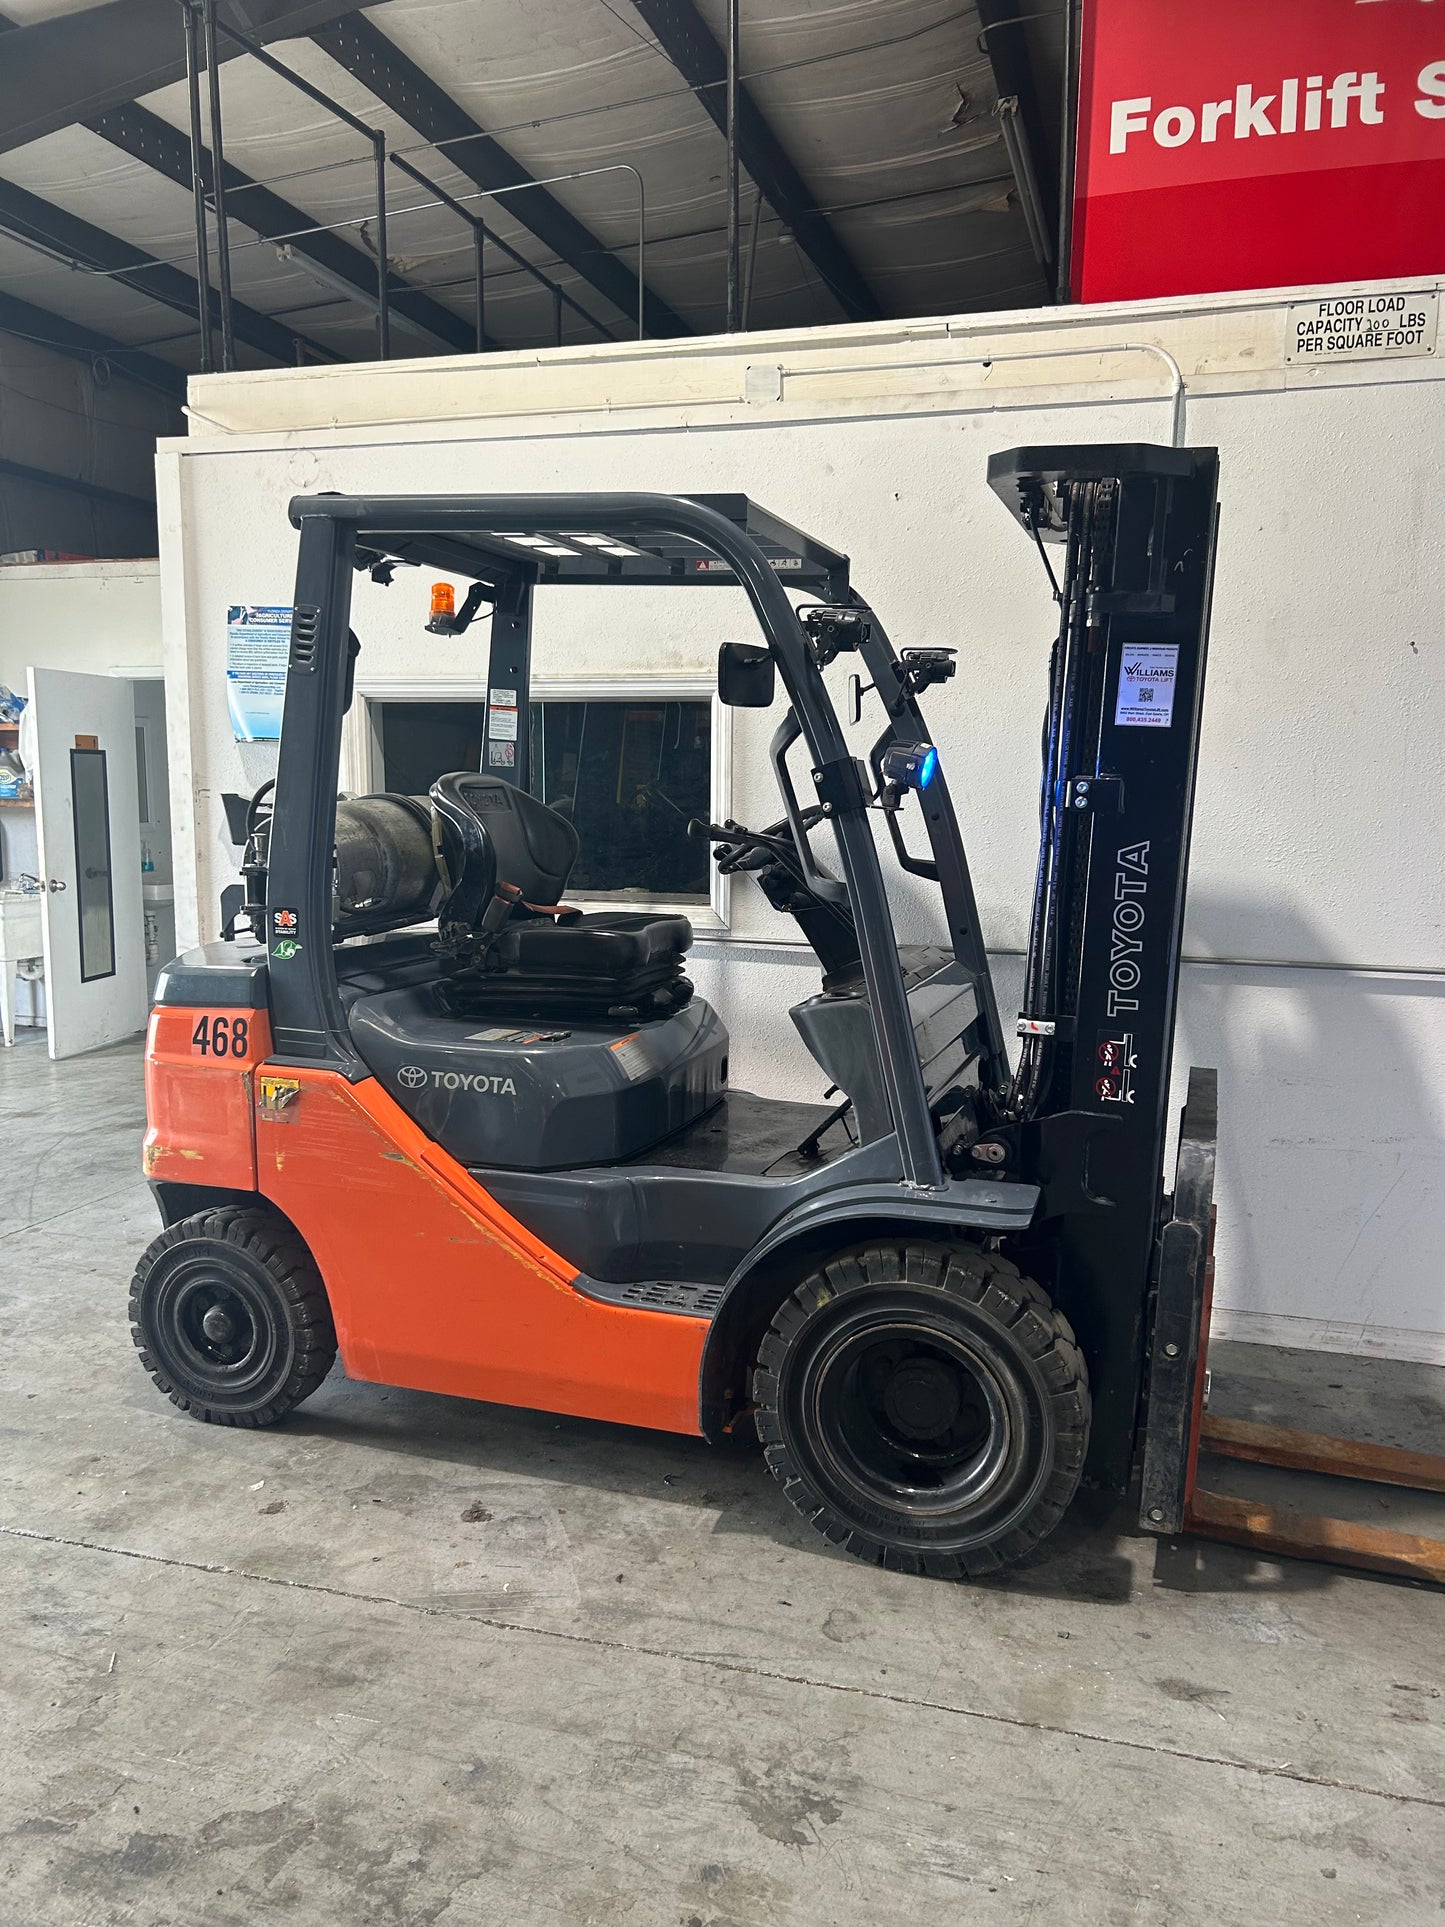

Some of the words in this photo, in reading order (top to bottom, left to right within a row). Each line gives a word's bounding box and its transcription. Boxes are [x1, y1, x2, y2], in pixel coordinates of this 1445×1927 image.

[1109, 71, 1385, 155] Forklift
[1319, 299, 1364, 317] FLOOR
[1368, 297, 1405, 313] LOAD
[1296, 317, 1363, 336] CAPACITY
[1400, 312, 1426, 328] LBS
[1297, 337, 1323, 353] PER
[1327, 333, 1382, 350] SQUARE
[1386, 330, 1424, 346] FOOT
[1124, 661, 1175, 677] WILLIAMS
[274, 910, 297, 927] SAS
[1107, 840, 1150, 1017] TOYOTA
[192, 1016, 249, 1058] 468
[431, 1071, 517, 1096] TOYOTA
